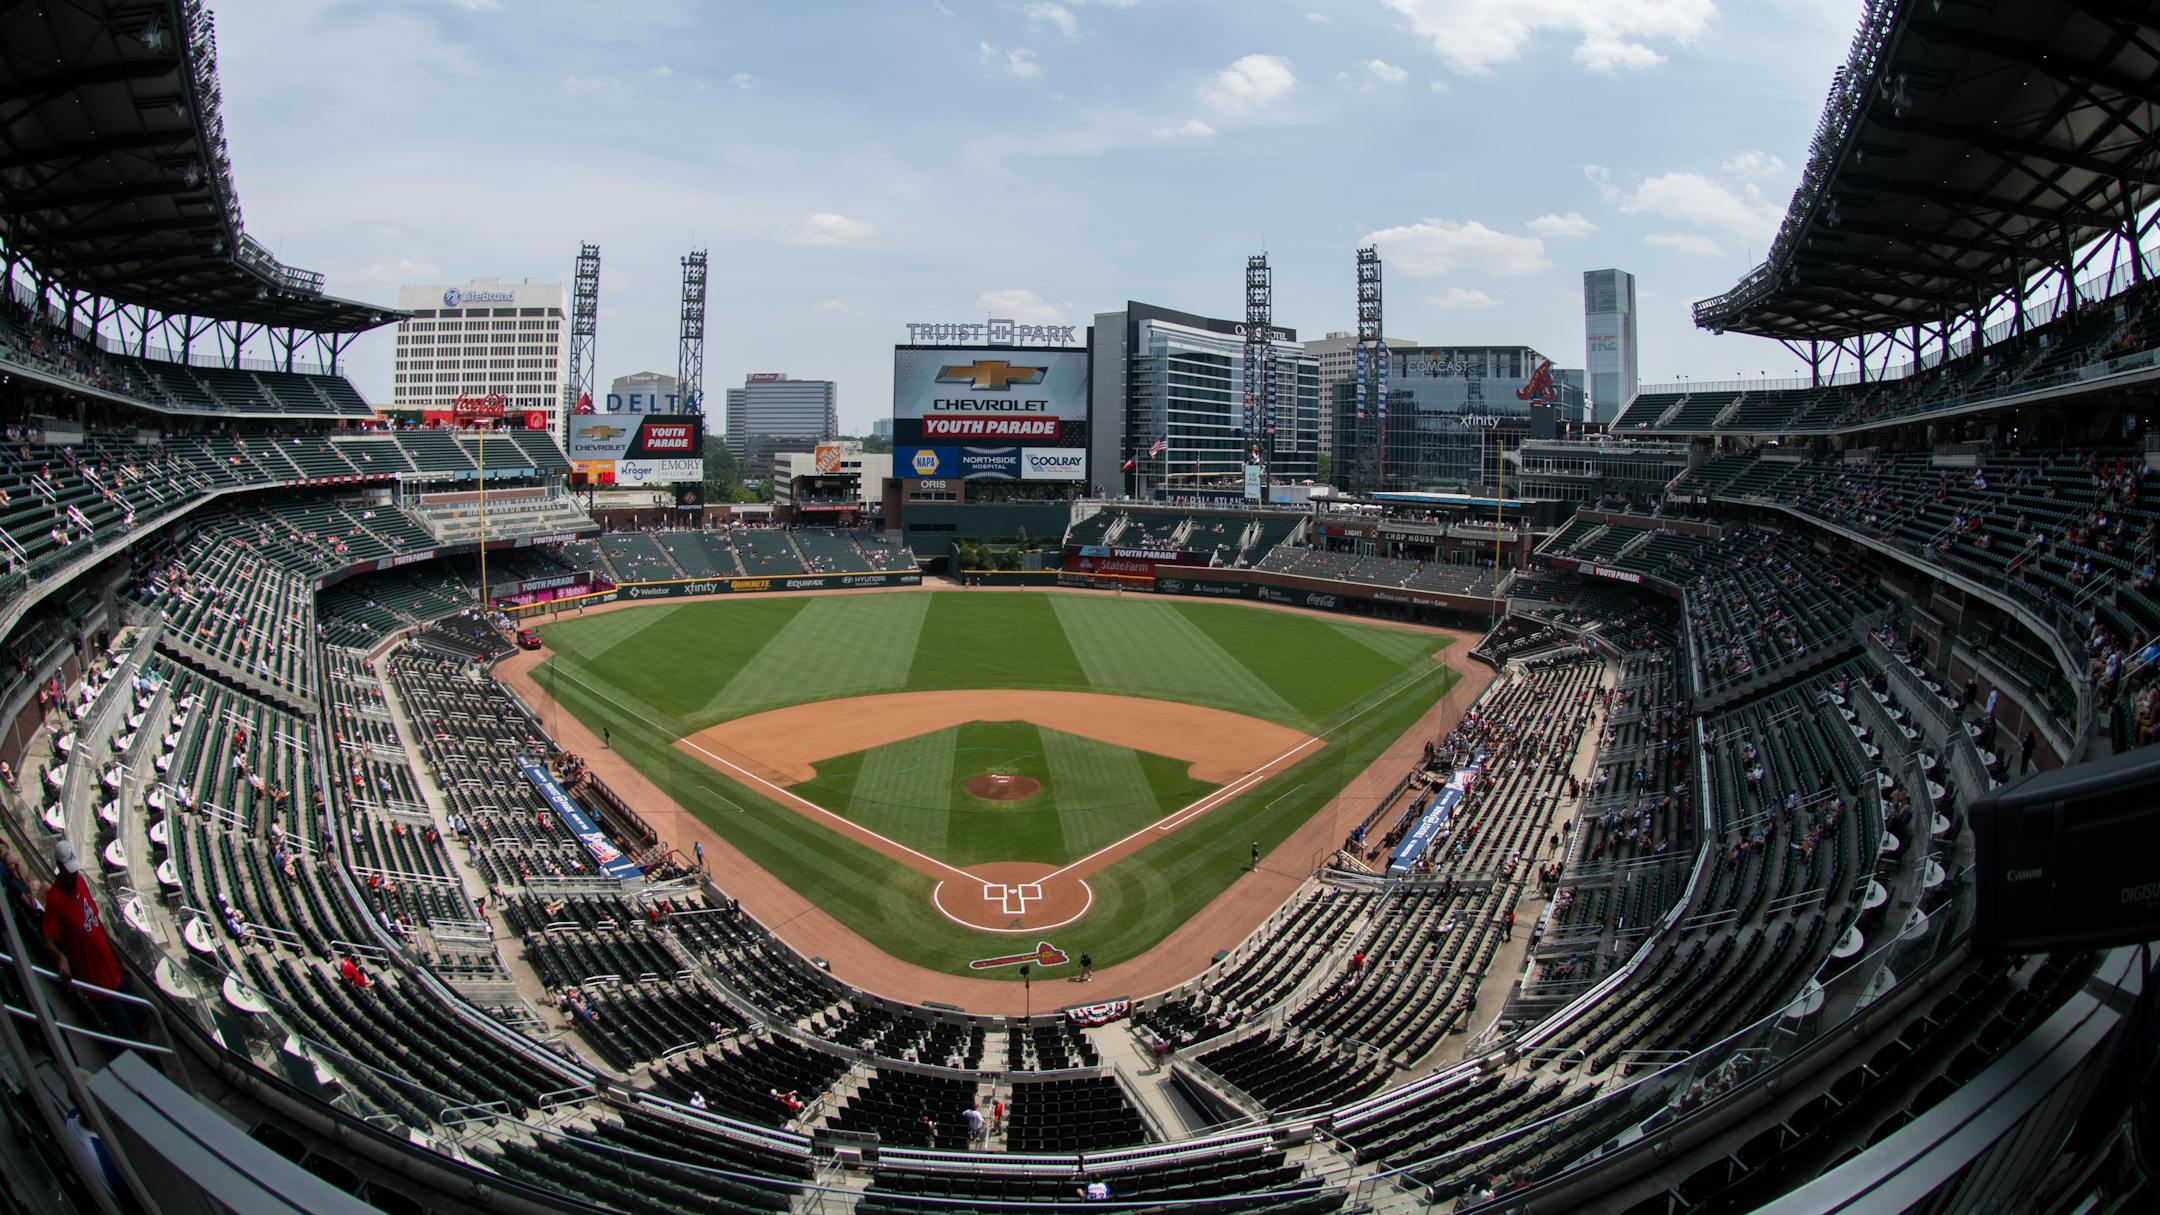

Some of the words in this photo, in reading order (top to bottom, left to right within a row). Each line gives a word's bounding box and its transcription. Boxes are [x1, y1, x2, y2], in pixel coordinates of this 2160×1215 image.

[906, 323, 983, 340] TRUIST
[1019, 325, 1076, 342] PARK
[1407, 361, 1469, 372] COMCAST
[606, 393, 700, 413] DELTA
[933, 399, 1048, 411] CHEVROLET
[1460, 413, 1501, 429] xfinity
[651, 427, 686, 437] YOUTH
[926, 419, 984, 434] YOUTH
[984, 420, 1056, 435] PARADE
[575, 444, 627, 452] CHEVROLET
[647, 438, 689, 448] PARADE
[661, 460, 701, 470] EMORY
[916, 456, 935, 468] NAPA
[962, 456, 1017, 464] NORTHSIDE
[1030, 456, 1082, 466] COOLRAY
[621, 461, 653, 481] Kroger
[920, 479, 946, 489] ORIS
[532, 535, 551, 545] YOUTH
[551, 533, 577, 543] PARADE
[1408, 534, 1435, 543] HOUSE
[1113, 549, 1143, 558] YOUTH
[1143, 550, 1177, 560] PARADE
[1595, 567, 1616, 578] YOUTH
[522, 580, 547, 591] YOUTH
[547, 576, 574, 587] PARADE
[786, 579, 824, 588] EQUIFAX
[854, 575, 886, 583] HYUNDAI
[640, 587, 670, 596] Wellstar
[684, 582, 718, 595] xfinity
[1202, 585, 1224, 594] Georgia
[1224, 586, 1241, 594] Power
[2006, 867, 2043, 882] Canon
